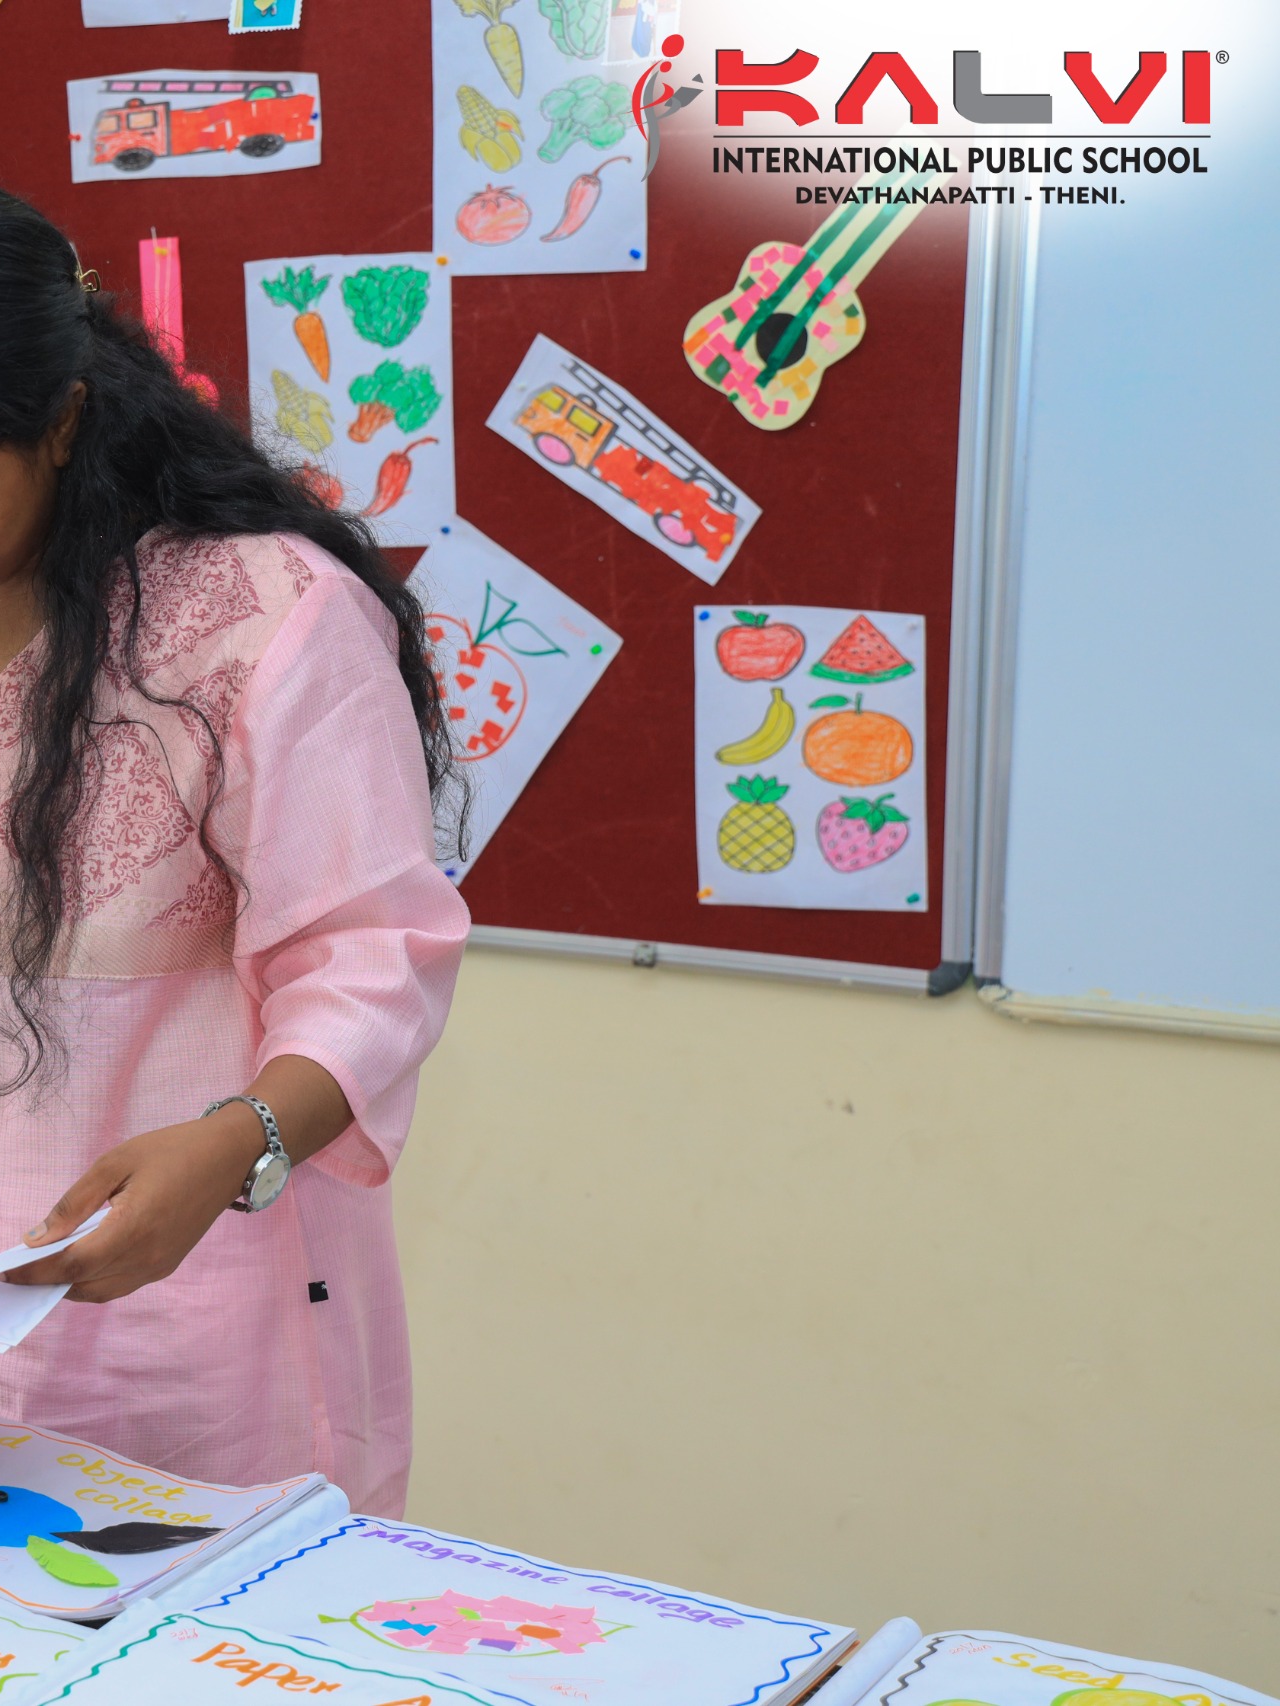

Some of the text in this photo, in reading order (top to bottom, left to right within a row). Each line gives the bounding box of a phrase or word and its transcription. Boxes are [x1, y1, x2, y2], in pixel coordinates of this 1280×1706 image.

[56, 1453, 188, 1501] Object
[358, 1529, 569, 1585] Magazine
[191, 1641, 343, 1694] Paper
[992, 1652, 1126, 1690] Seed
